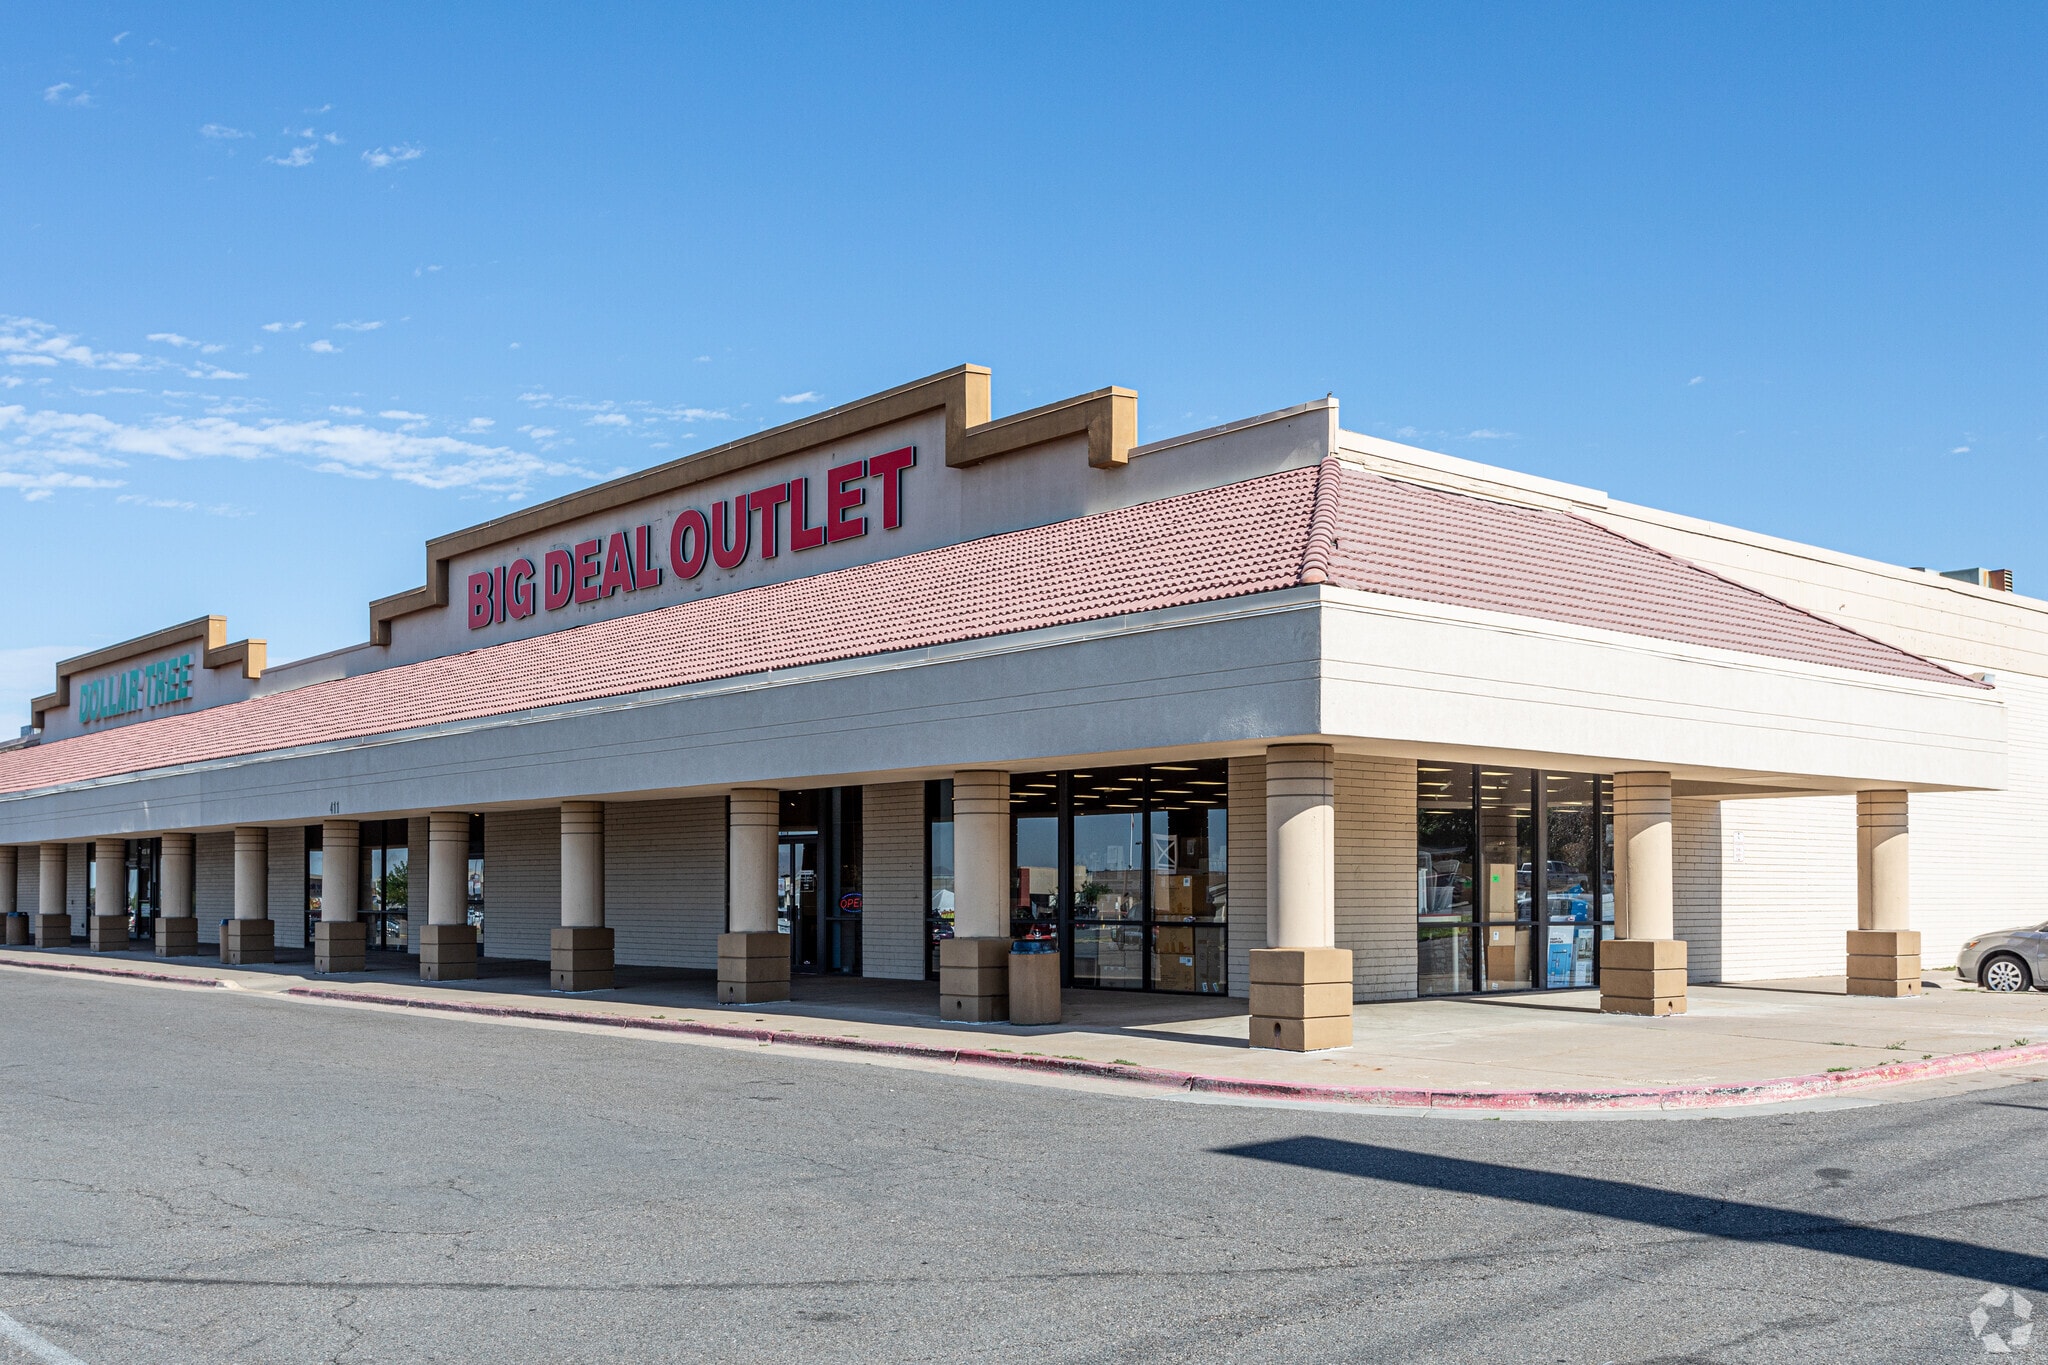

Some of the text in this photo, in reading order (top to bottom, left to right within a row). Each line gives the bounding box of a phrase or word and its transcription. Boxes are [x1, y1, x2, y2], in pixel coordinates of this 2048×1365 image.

[468, 446, 916, 630] BIG DEAL OUTLET
[80, 653, 194, 723] DOLLAR TREE
[330, 800, 340, 815] 411
